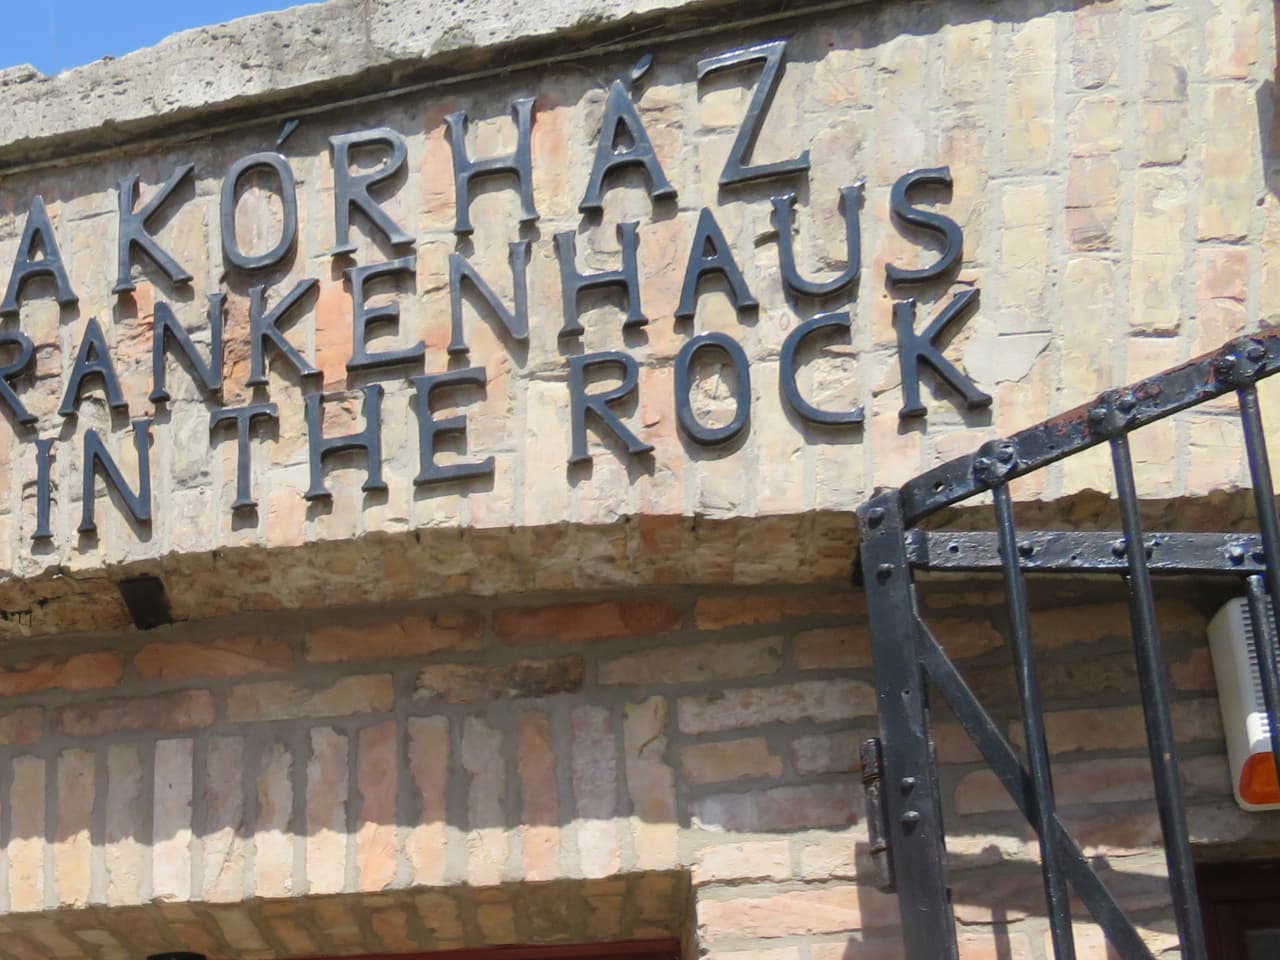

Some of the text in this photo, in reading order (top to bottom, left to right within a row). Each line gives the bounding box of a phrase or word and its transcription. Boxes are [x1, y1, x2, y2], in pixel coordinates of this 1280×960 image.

[32, 418, 154, 541] IN
[210, 366, 495, 511] THE
[567, 288, 993, 465] ROCK
